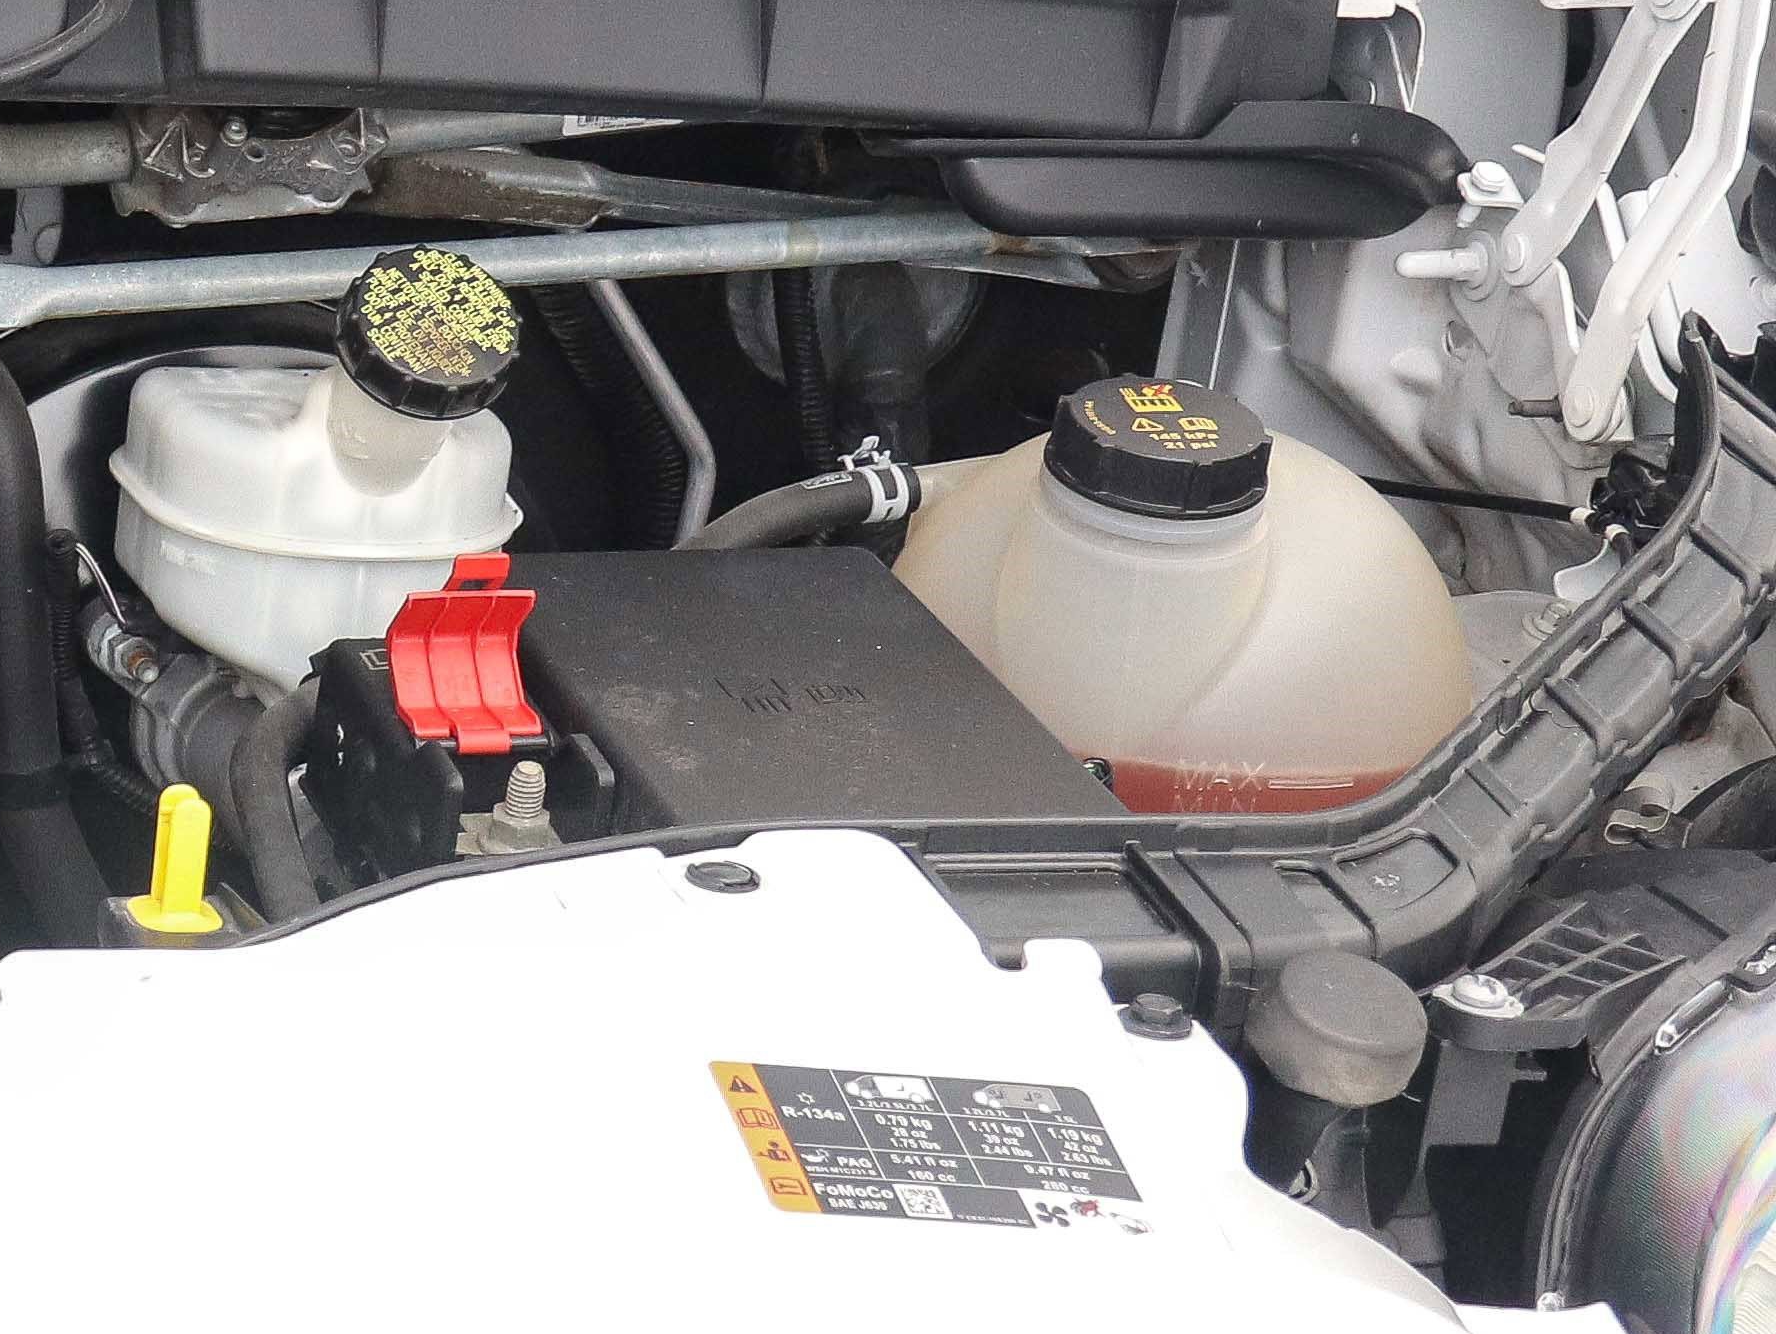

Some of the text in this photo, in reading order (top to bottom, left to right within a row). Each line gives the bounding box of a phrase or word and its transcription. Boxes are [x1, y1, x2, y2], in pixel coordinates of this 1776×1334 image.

[409, 262, 423, 271] A
[419, 271, 451, 303] SEALED
[445, 253, 516, 328] CLEAN FILLER CAP
[370, 267, 398, 292] AVANT
[396, 292, 410, 305] DE
[406, 305, 422, 319] LE
[428, 250, 460, 281] BEFORE
[497, 324, 515, 341] USE
[413, 250, 509, 354] ONLY DOT 4 FLUID FROM
[387, 267, 476, 364] NETTOYER LE BOUCHON
[364, 291, 387, 309] DOT
[390, 321, 438, 370] PROVENANT
[366, 278, 457, 376] PLOYER QUE DU LIQUIDE
[381, 326, 427, 375] CONTENANT
[1184, 432, 1219, 440] kPa
[1163, 441, 1185, 450] 21
[1173, 759, 1264, 792] MAX
[781, 1105, 846, 1121] R-134a
[909, 1116, 933, 1131] kg
[968, 1121, 1025, 1137] 1.11 kg
[910, 1130, 928, 1138] oz
[1003, 1137, 1020, 1146] oz
[1047, 1127, 1104, 1146] 1.19 kg
[918, 1139, 941, 1150] lbs
[1011, 1147, 1034, 1157] lbs
[1064, 1141, 1099, 1155] 42 oz
[837, 1156, 872, 1168] PAG
[890, 1153, 921, 1165] 5.41
[938, 1159, 958, 1167] oz
[1089, 1154, 1113, 1167] lbs
[907, 1170, 956, 1182] 160 cc
[1024, 1164, 1054, 1175] 9.47
[1071, 1171, 1091, 1180] oz
[813, 1182, 894, 1199] FoMoCo
[1070, 1185, 1090, 1194] cc
[828, 1198, 857, 1209] SAE
